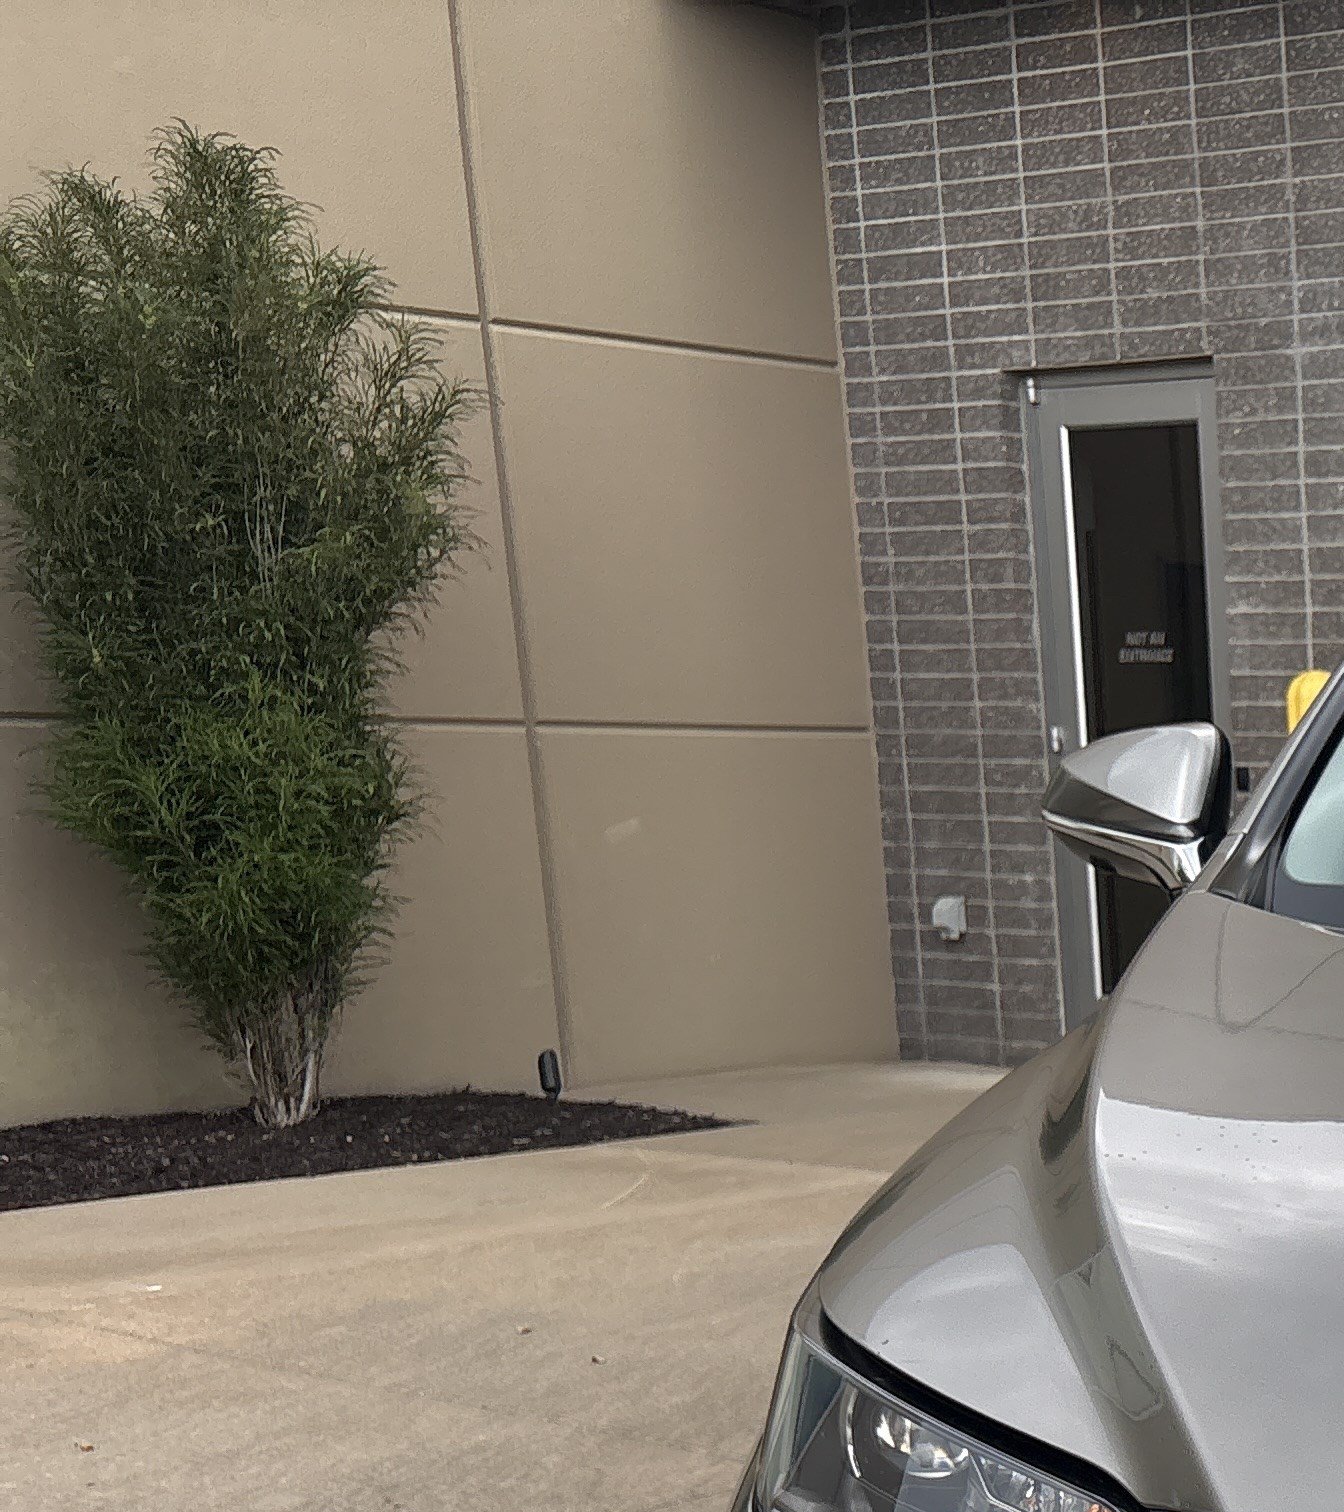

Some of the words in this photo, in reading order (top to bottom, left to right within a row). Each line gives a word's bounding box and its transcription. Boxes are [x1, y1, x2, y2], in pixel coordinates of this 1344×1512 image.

[1124, 631, 1149, 646] NOT
[1150, 631, 1166, 646] AN
[1119, 648, 1174, 664] ENTRANCE
